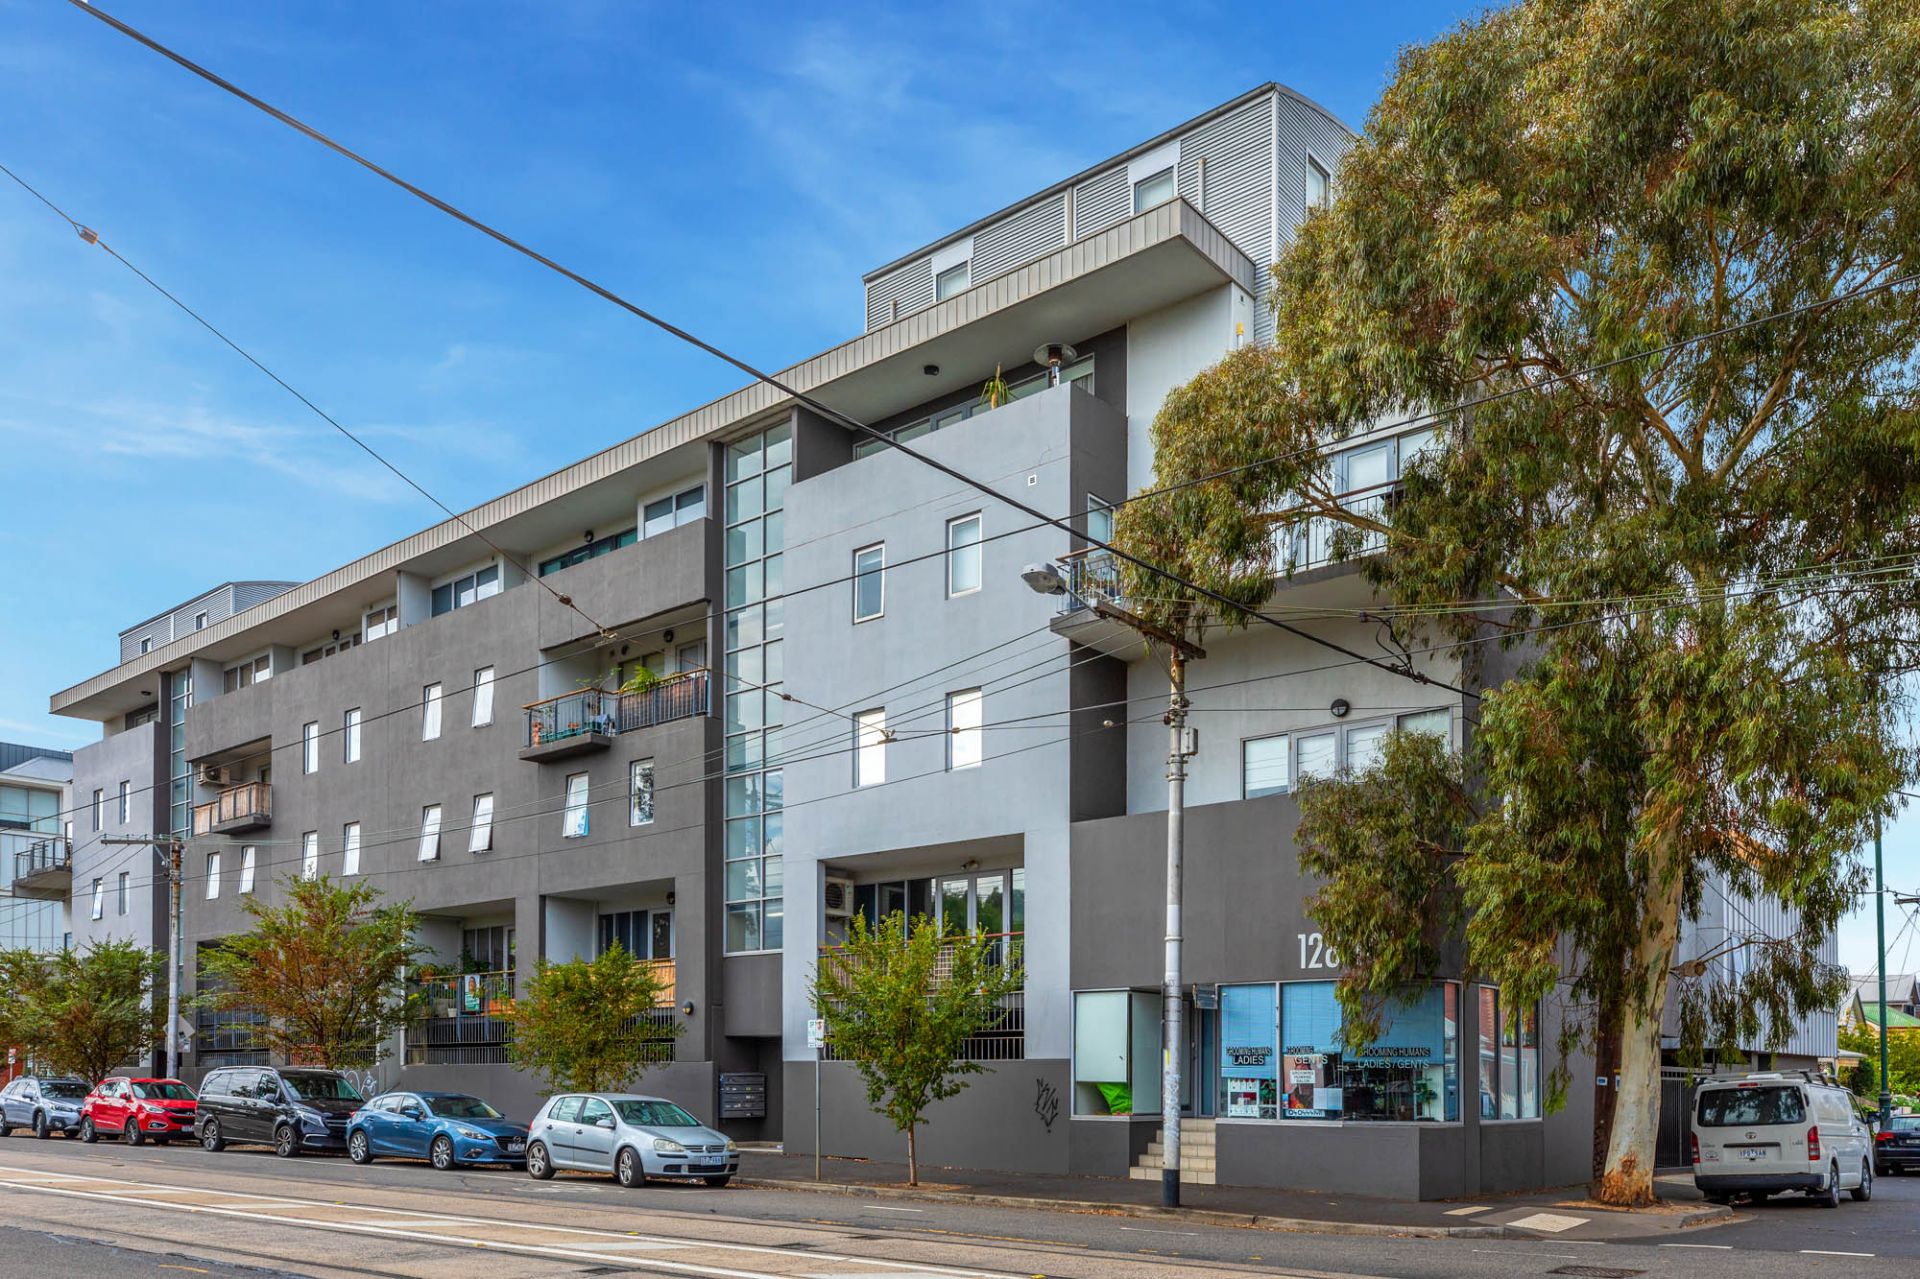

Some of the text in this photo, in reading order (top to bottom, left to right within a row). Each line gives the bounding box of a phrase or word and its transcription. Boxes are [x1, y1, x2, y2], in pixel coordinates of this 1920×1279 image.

[1399, 1047, 1431, 1056] HUMANS
[1233, 1055, 1265, 1065] LADIES
[1358, 1059, 1391, 1069] LADIES
[1397, 1059, 1430, 1069] GENTS
